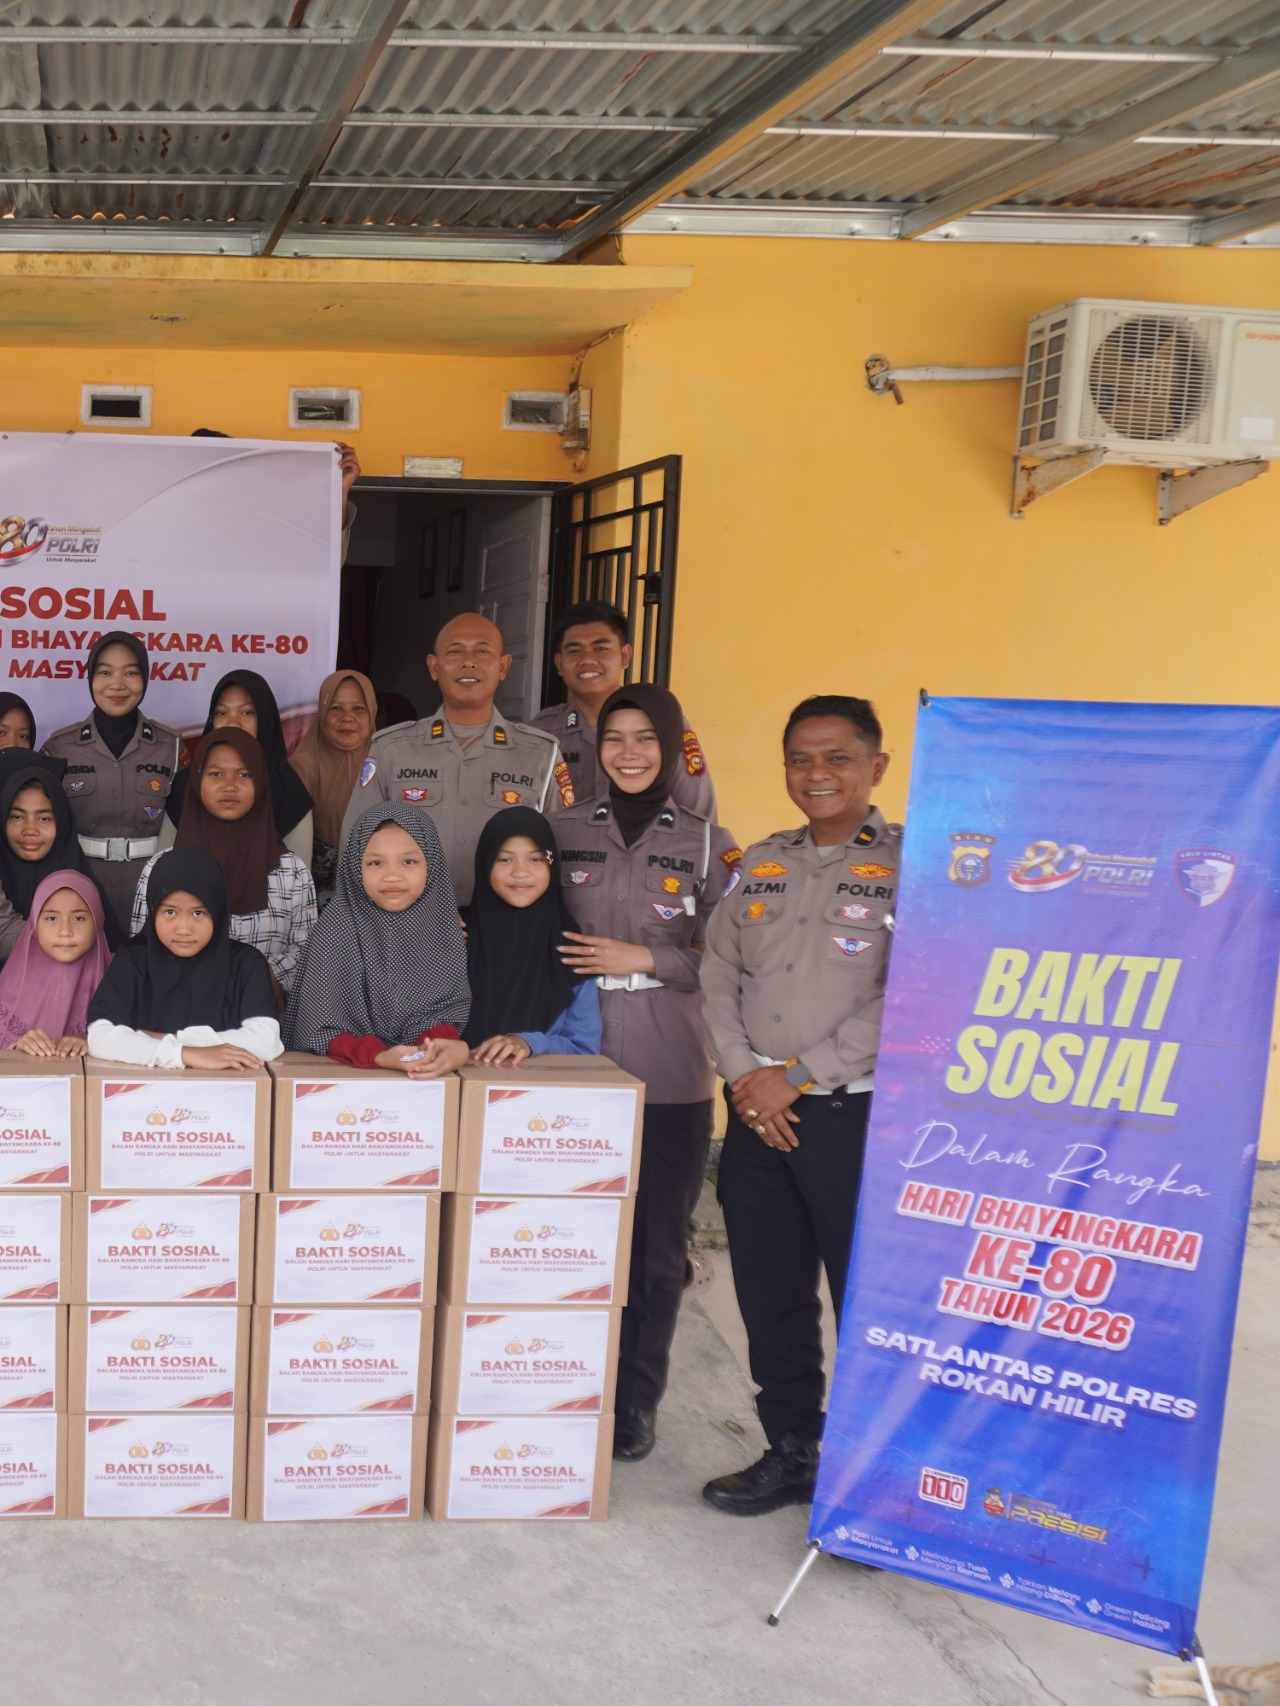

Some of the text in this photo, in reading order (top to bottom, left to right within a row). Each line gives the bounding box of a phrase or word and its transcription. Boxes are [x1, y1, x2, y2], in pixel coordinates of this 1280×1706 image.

[46, 537, 100, 553] POLRI
[0, 586, 167, 621] SOSIAL
[11, 630, 224, 653] BHAYAGKARA
[231, 634, 309, 655] KE-80
[8, 659, 207, 682] MASYKAT
[136, 764, 171, 777] POLRI
[397, 768, 534, 788] JOHAN POLRI
[954, 834, 993, 844] RIAU
[561, 850, 695, 874] NINGSIH POLRI
[1008, 840, 1087, 893] 80
[1082, 866, 1154, 886] POLRI
[742, 882, 894, 901] AZMI POLRI
[973, 947, 1182, 1031] BAKTI
[946, 1025, 1181, 1116] SOSIAL
[121, 1131, 237, 1144] BAKTI SOSIAL
[311, 1130, 424, 1143] BAKTI SOSIAL
[502, 1136, 613, 1150] BAKTI SOSIAL
[898, 1119, 1211, 1205] Dalam Rangka
[896, 1181, 1204, 1271] HARI BHAYANGKARA
[107, 1245, 219, 1257] BAKTI SOSIAL
[295, 1246, 406, 1258] BAKTI SOSIAL
[489, 1247, 598, 1260] BAKTI SOSIAL
[964, 1233, 1117, 1305] KE-80
[936, 1278, 1135, 1351] TAHUN 2026
[106, 1355, 217, 1367] BAKTI SOSIAL
[289, 1358, 398, 1369] BAKTI SOSIAL
[480, 1360, 587, 1371] BAKTI SOSIAL
[866, 1327, 1199, 1420] SATLANTAS POLRES
[919, 1361, 1127, 1428] ROKAN HILIR
[283, 1464, 391, 1477] BAKTI SOSIAL
[924, 1475, 964, 1503] 110
[1010, 1505, 1108, 1542] PRESISI
[852, 1536, 899, 1555] Masyarakat
[957, 1566, 992, 1582] Marwah
